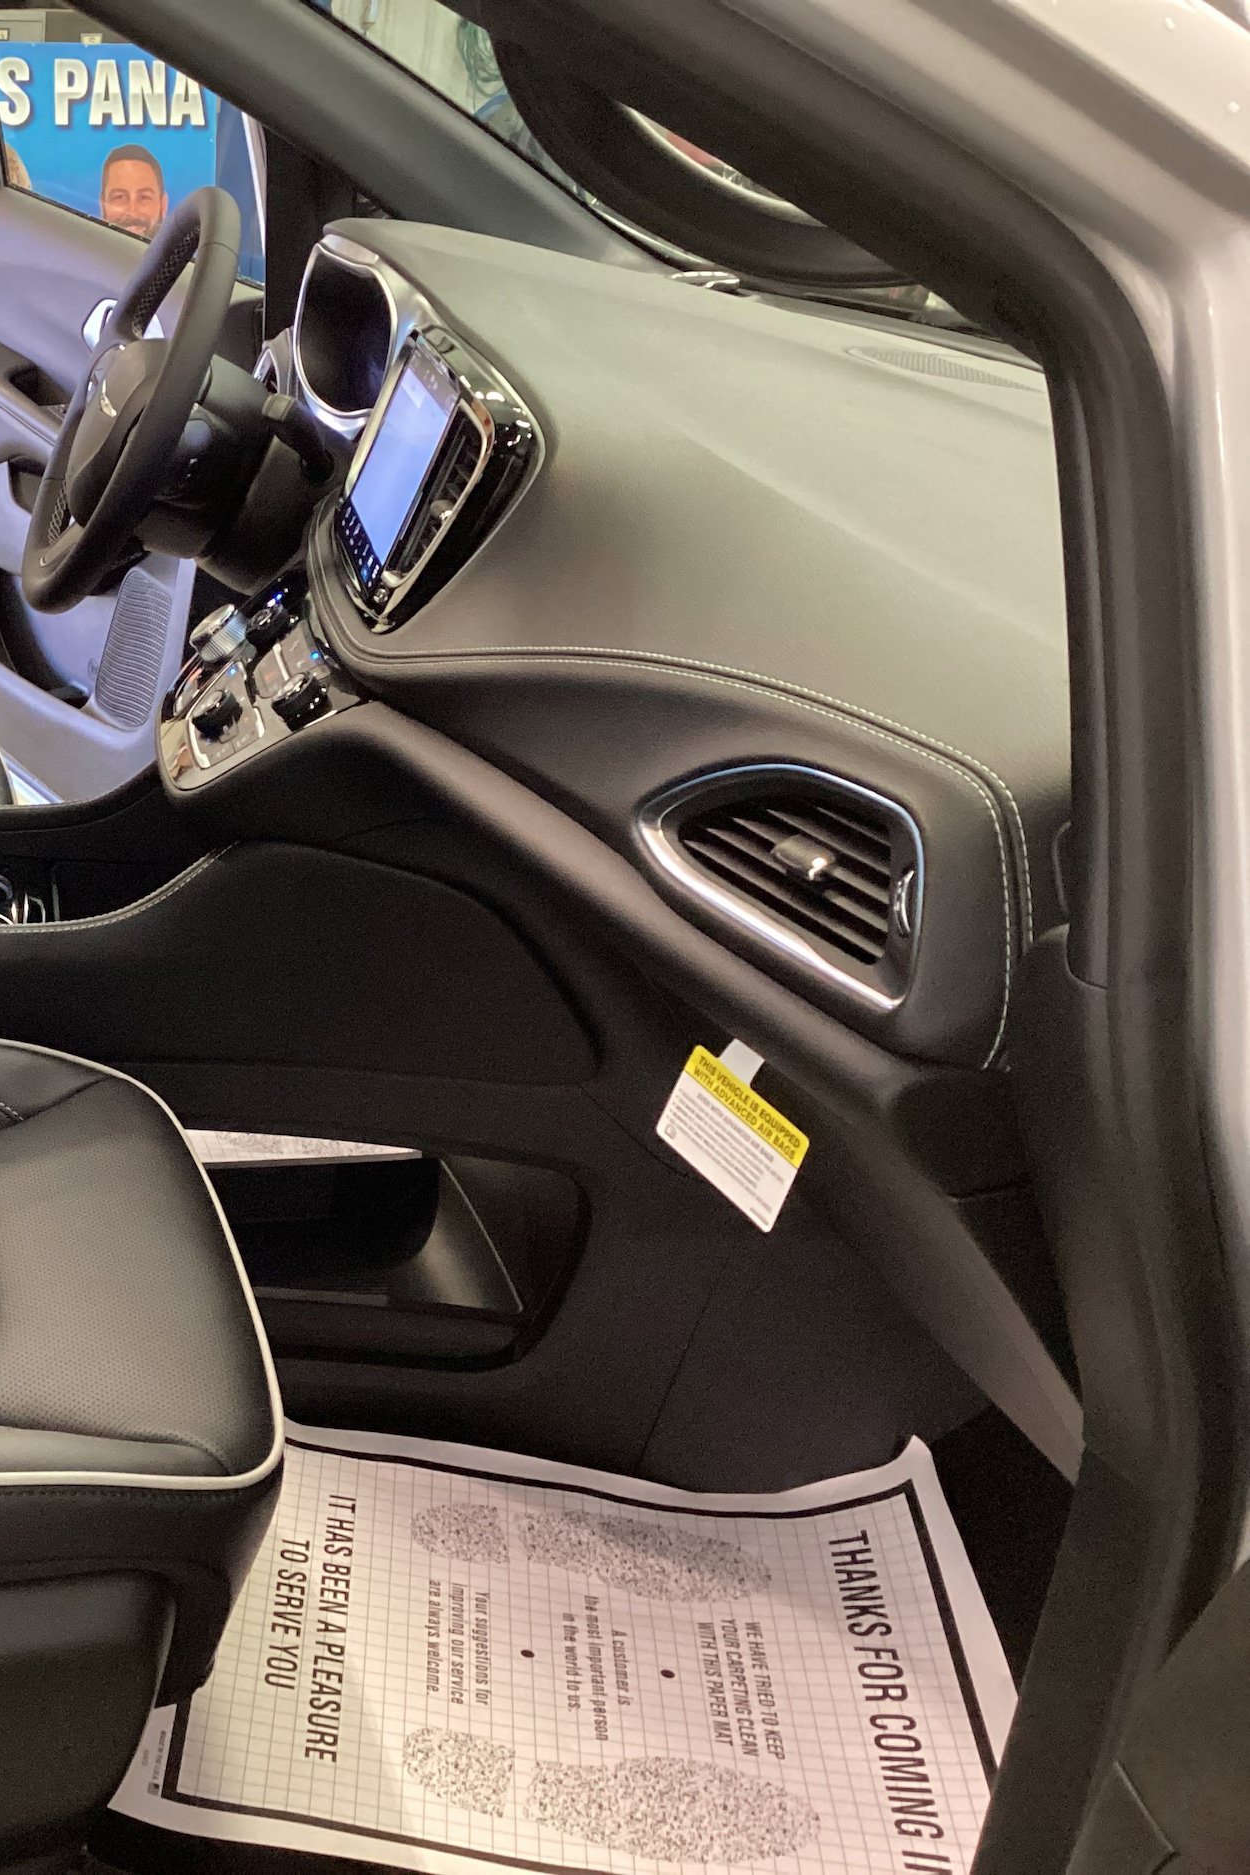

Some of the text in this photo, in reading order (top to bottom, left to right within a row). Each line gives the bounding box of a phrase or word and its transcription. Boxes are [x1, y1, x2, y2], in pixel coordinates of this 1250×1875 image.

[54, 58, 206, 126] PANA
[693, 1066, 796, 1160] WITH ADVANCED AIR BAGS
[698, 1056, 801, 1149] THIS VEHICLE IS EQUIPPED
[263, 1539, 310, 1689] TO SERVE YOU
[304, 1494, 355, 1762] IT HAS BEEN A PLEASURE
[426, 1580, 443, 1694] are always welcome.
[827, 1530, 893, 1636] THANKS
[448, 1583, 467, 1704] improving our service
[471, 1592, 490, 1705] Your suggestions for
[562, 1613, 582, 1711] in the world to us.
[584, 1595, 608, 1740] the most important person
[612, 1640, 631, 1692] customer
[617, 1695, 633, 1705] is
[697, 1622, 732, 1746] WITH THIS PAPER MAT
[720, 1619, 759, 1756] YOUR CARPETING CLEAN
[744, 1621, 785, 1759] WE HAVE TRIED TO KEEP
[853, 1646, 910, 1701] FOR
[868, 1714, 944, 1837] COMING
